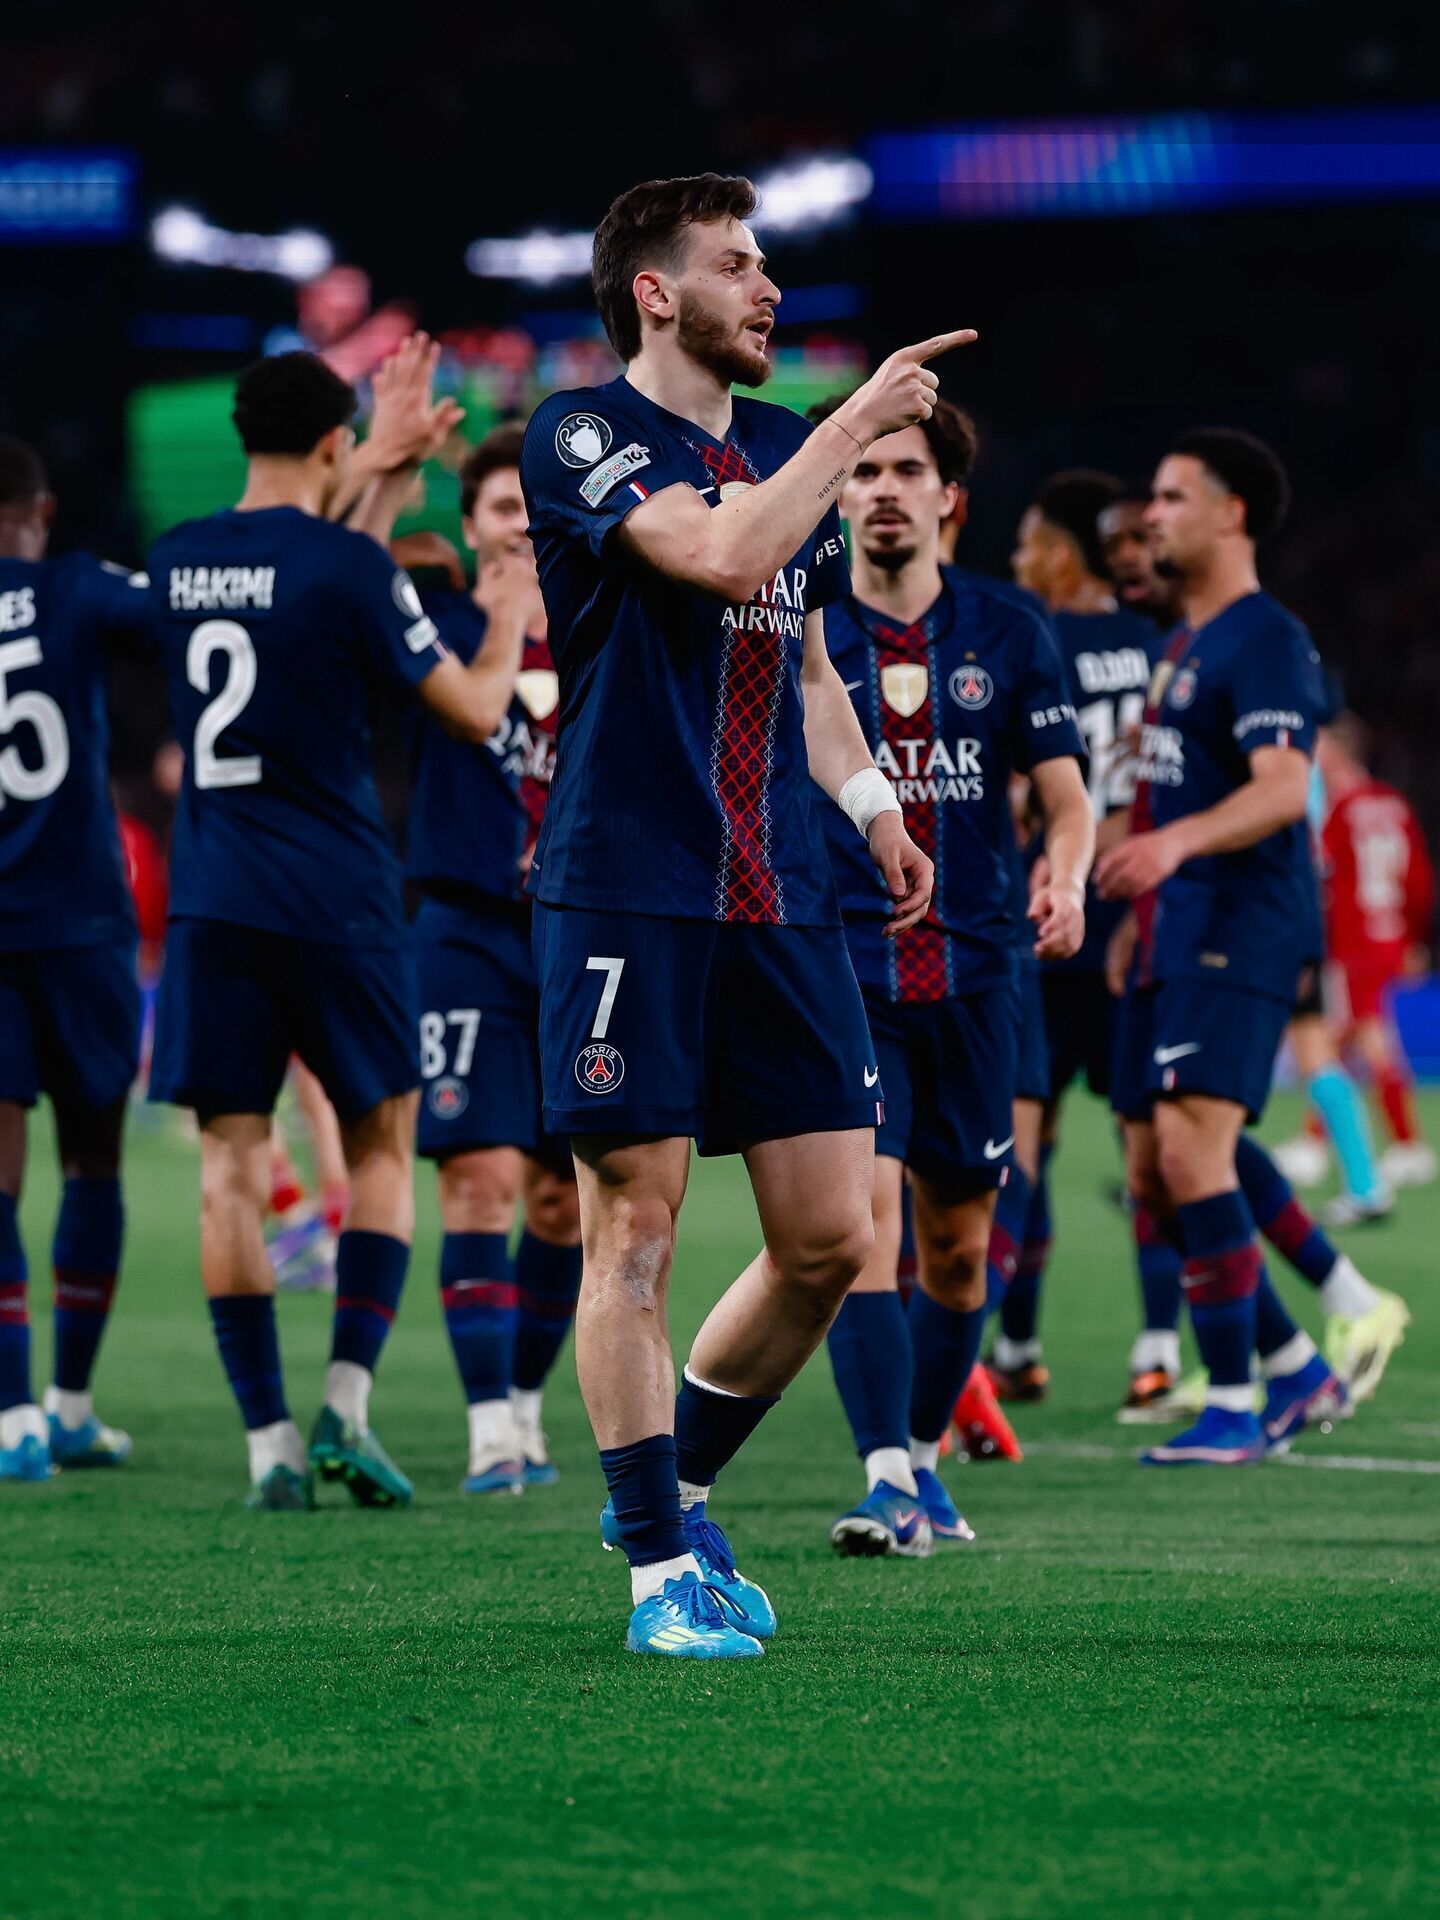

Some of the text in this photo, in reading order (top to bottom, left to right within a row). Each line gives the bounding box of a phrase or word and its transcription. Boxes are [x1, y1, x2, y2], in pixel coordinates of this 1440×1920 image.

[169, 566, 276, 610] HAKIMI
[186, 618, 262, 790] 2
[586, 956, 625, 1039] 7
[419, 1009, 482, 1079] 87
[583, 1046, 617, 1060] PARIS
